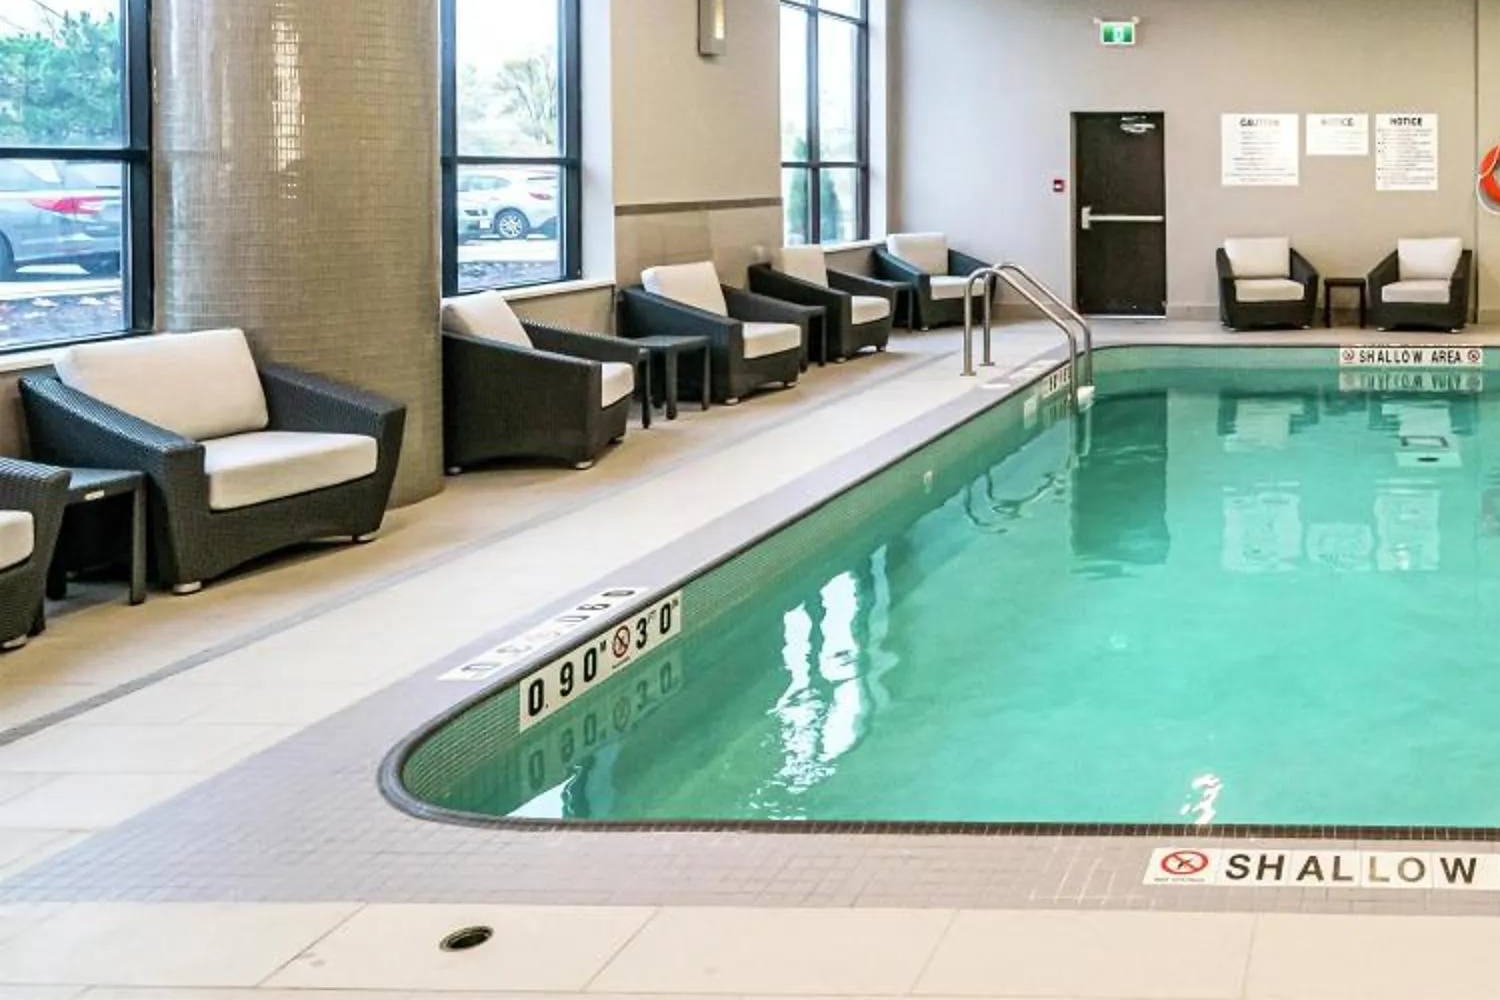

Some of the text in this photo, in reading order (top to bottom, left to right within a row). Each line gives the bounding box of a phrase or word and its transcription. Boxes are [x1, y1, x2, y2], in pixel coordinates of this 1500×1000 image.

[1321, 117, 1355, 127] NCE
[1389, 117, 1423, 127] NOTICE
[1360, 349, 1461, 363] SHALLOW AREA
[1225, 853, 1478, 885] SHALLOW
